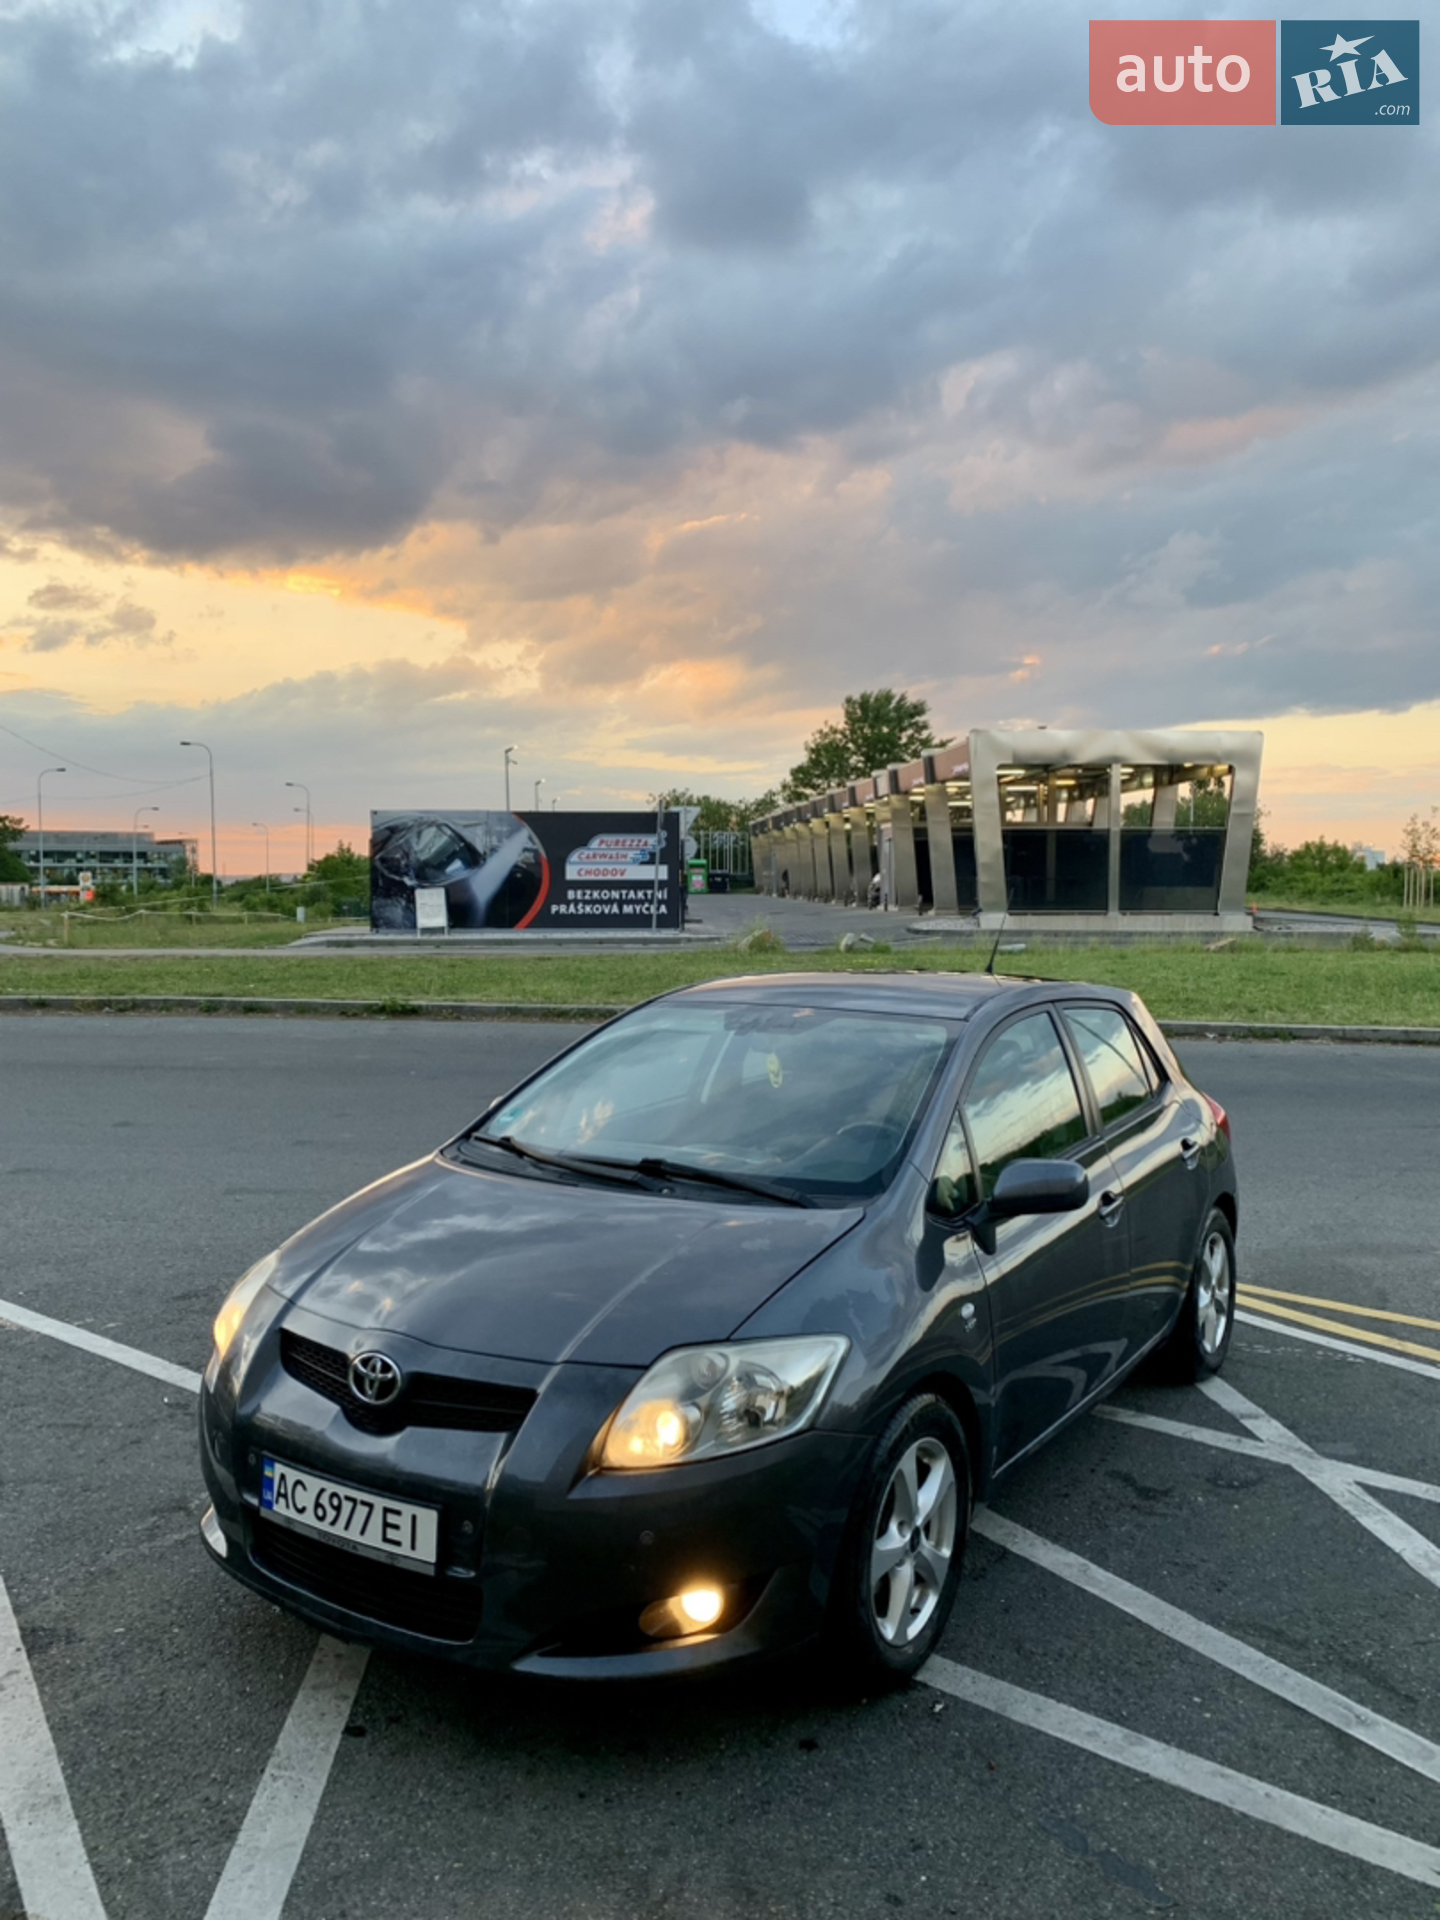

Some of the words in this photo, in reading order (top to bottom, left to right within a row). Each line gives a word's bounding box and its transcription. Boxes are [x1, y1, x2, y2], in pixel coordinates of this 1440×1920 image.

[597, 838, 650, 848] PUREZZA
[576, 867, 628, 877] CHODOV
[550, 901, 620, 915] PRÁŠKOVÁ
[275, 1472, 308, 1515] AC
[313, 1487, 375, 1537] 6977
[381, 1505, 417, 1552] EI
